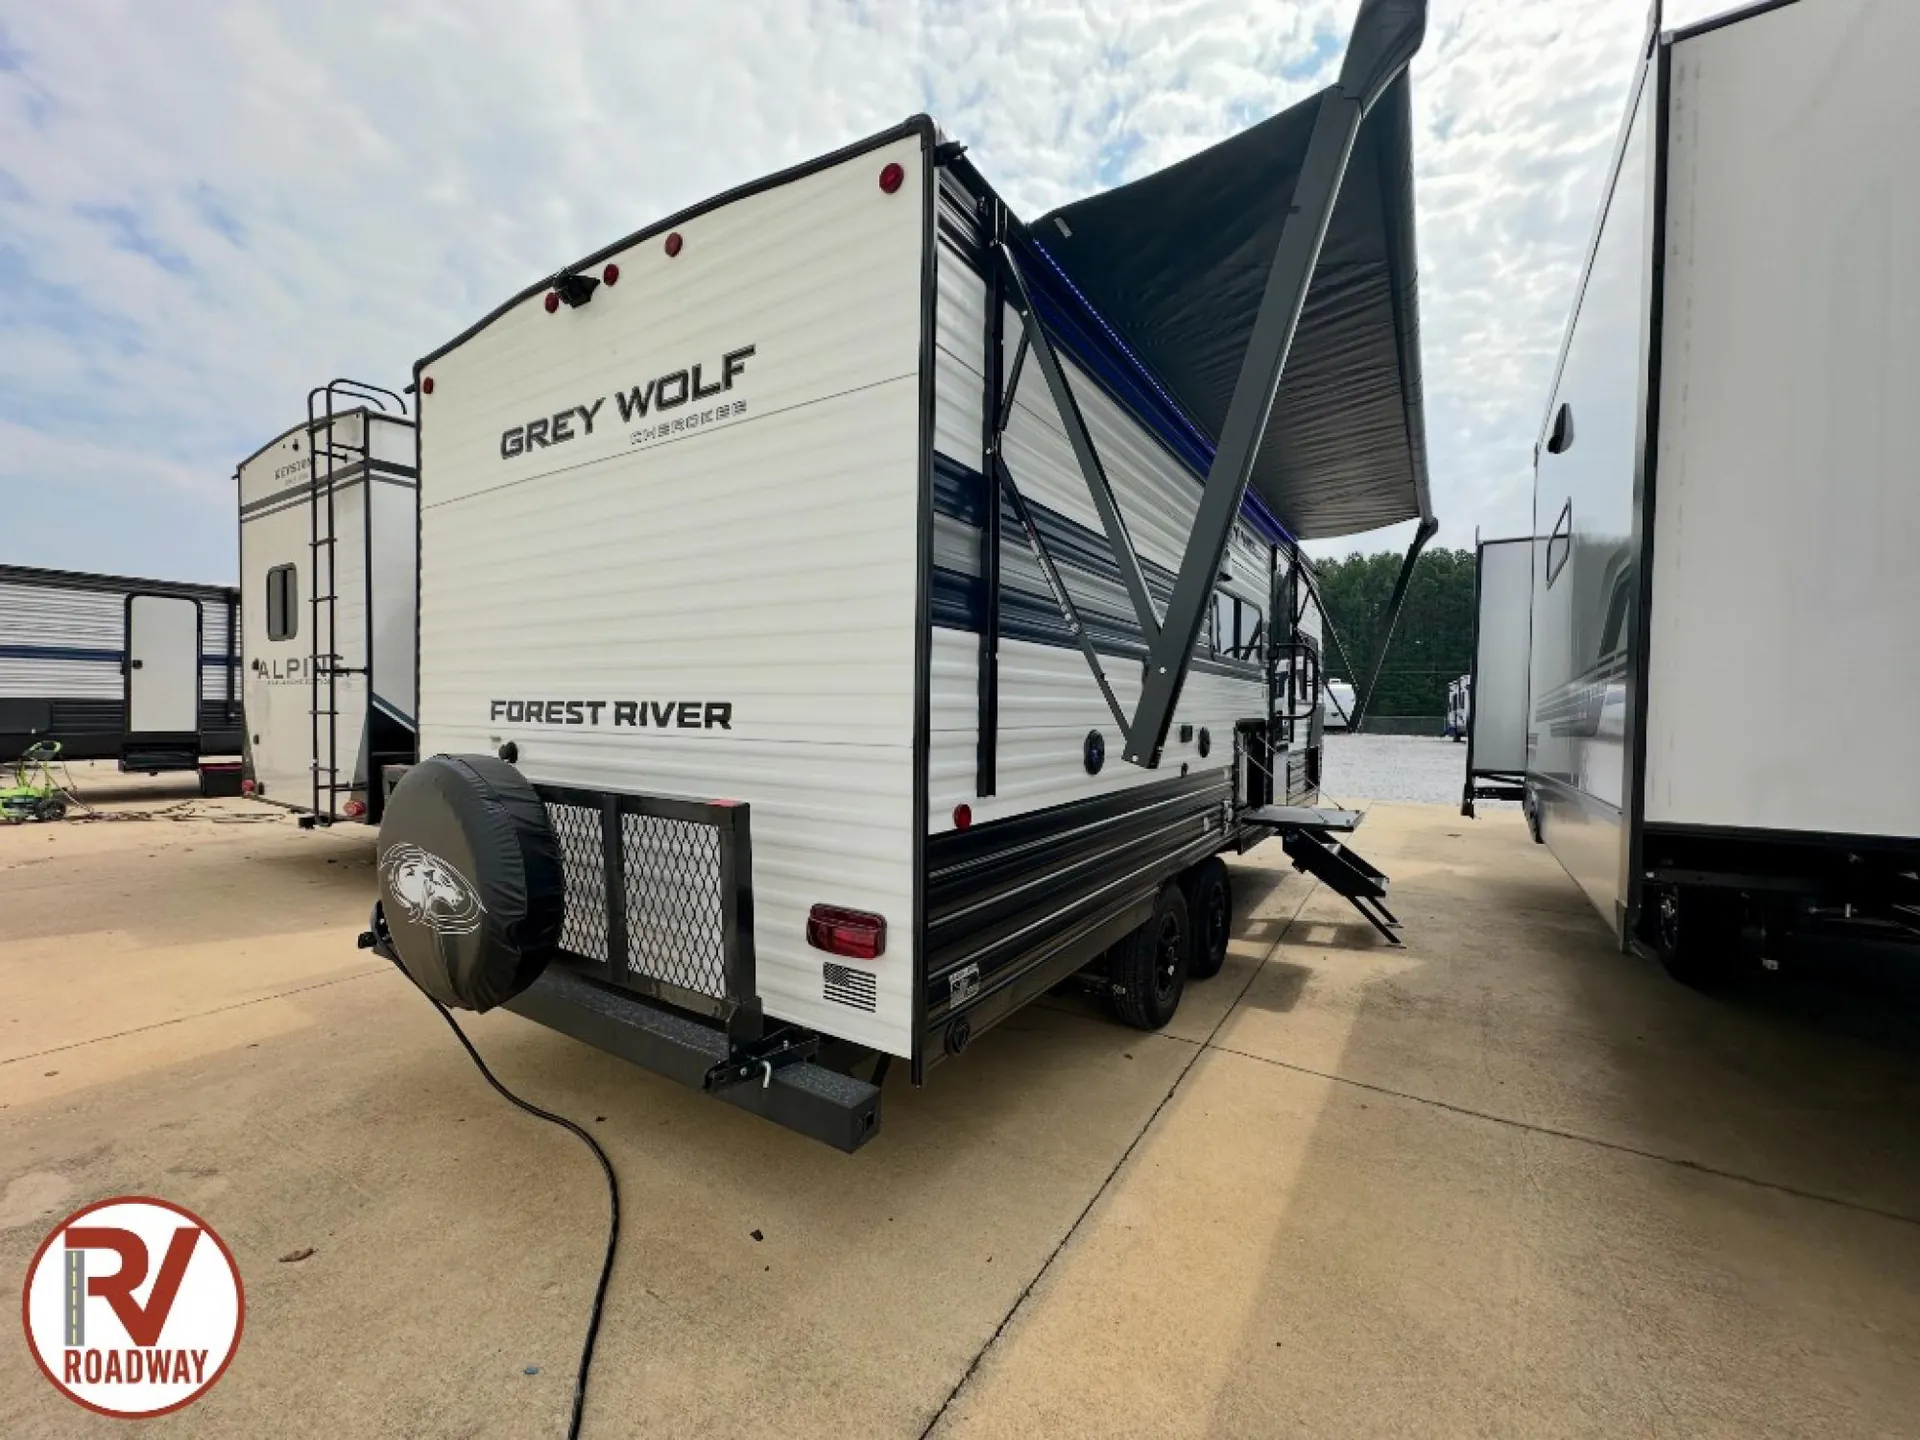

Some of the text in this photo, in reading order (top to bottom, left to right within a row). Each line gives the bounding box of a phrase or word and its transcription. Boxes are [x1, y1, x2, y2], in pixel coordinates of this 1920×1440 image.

[500, 343, 756, 460] GREY WOLF
[629, 399, 747, 445] CHEROKEE
[490, 700, 732, 730] FOREST RIVER
